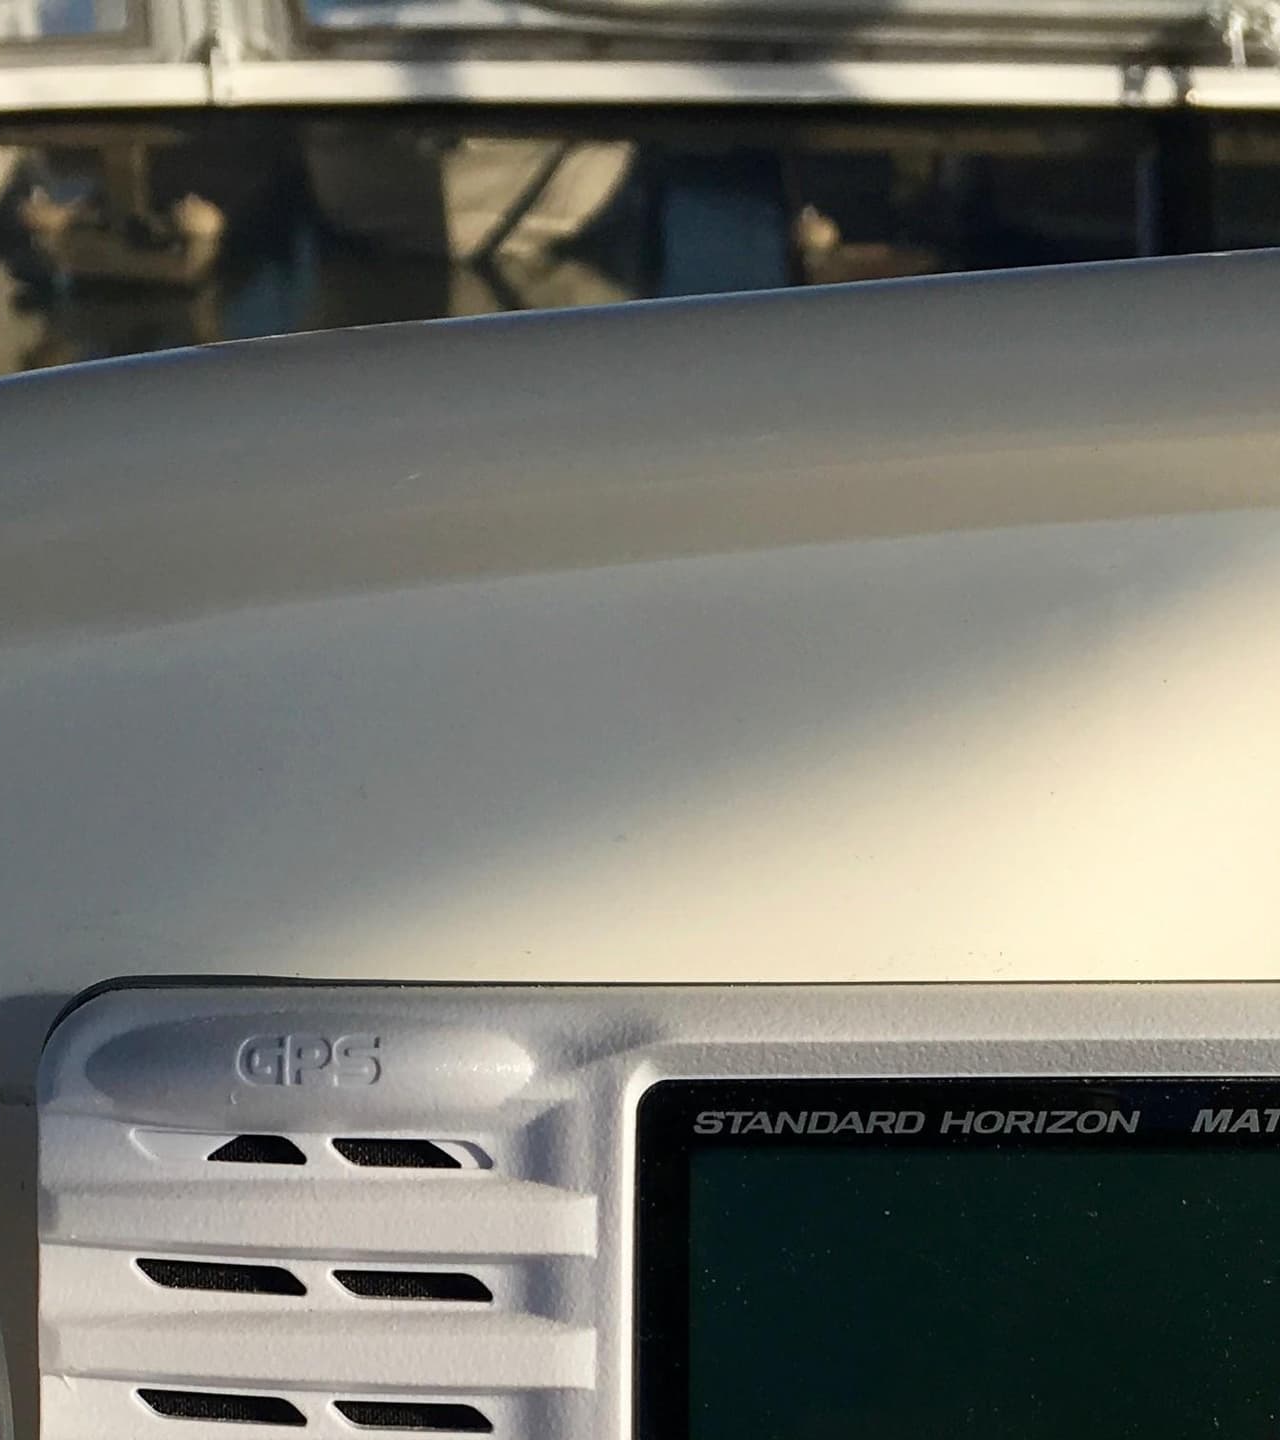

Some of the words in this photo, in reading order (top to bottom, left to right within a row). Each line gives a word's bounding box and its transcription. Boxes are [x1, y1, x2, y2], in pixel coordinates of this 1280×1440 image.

[235, 1034, 382, 1087] GPS
[693, 1110, 926, 1135] STANDARD
[939, 1110, 1141, 1135] HORIZON
